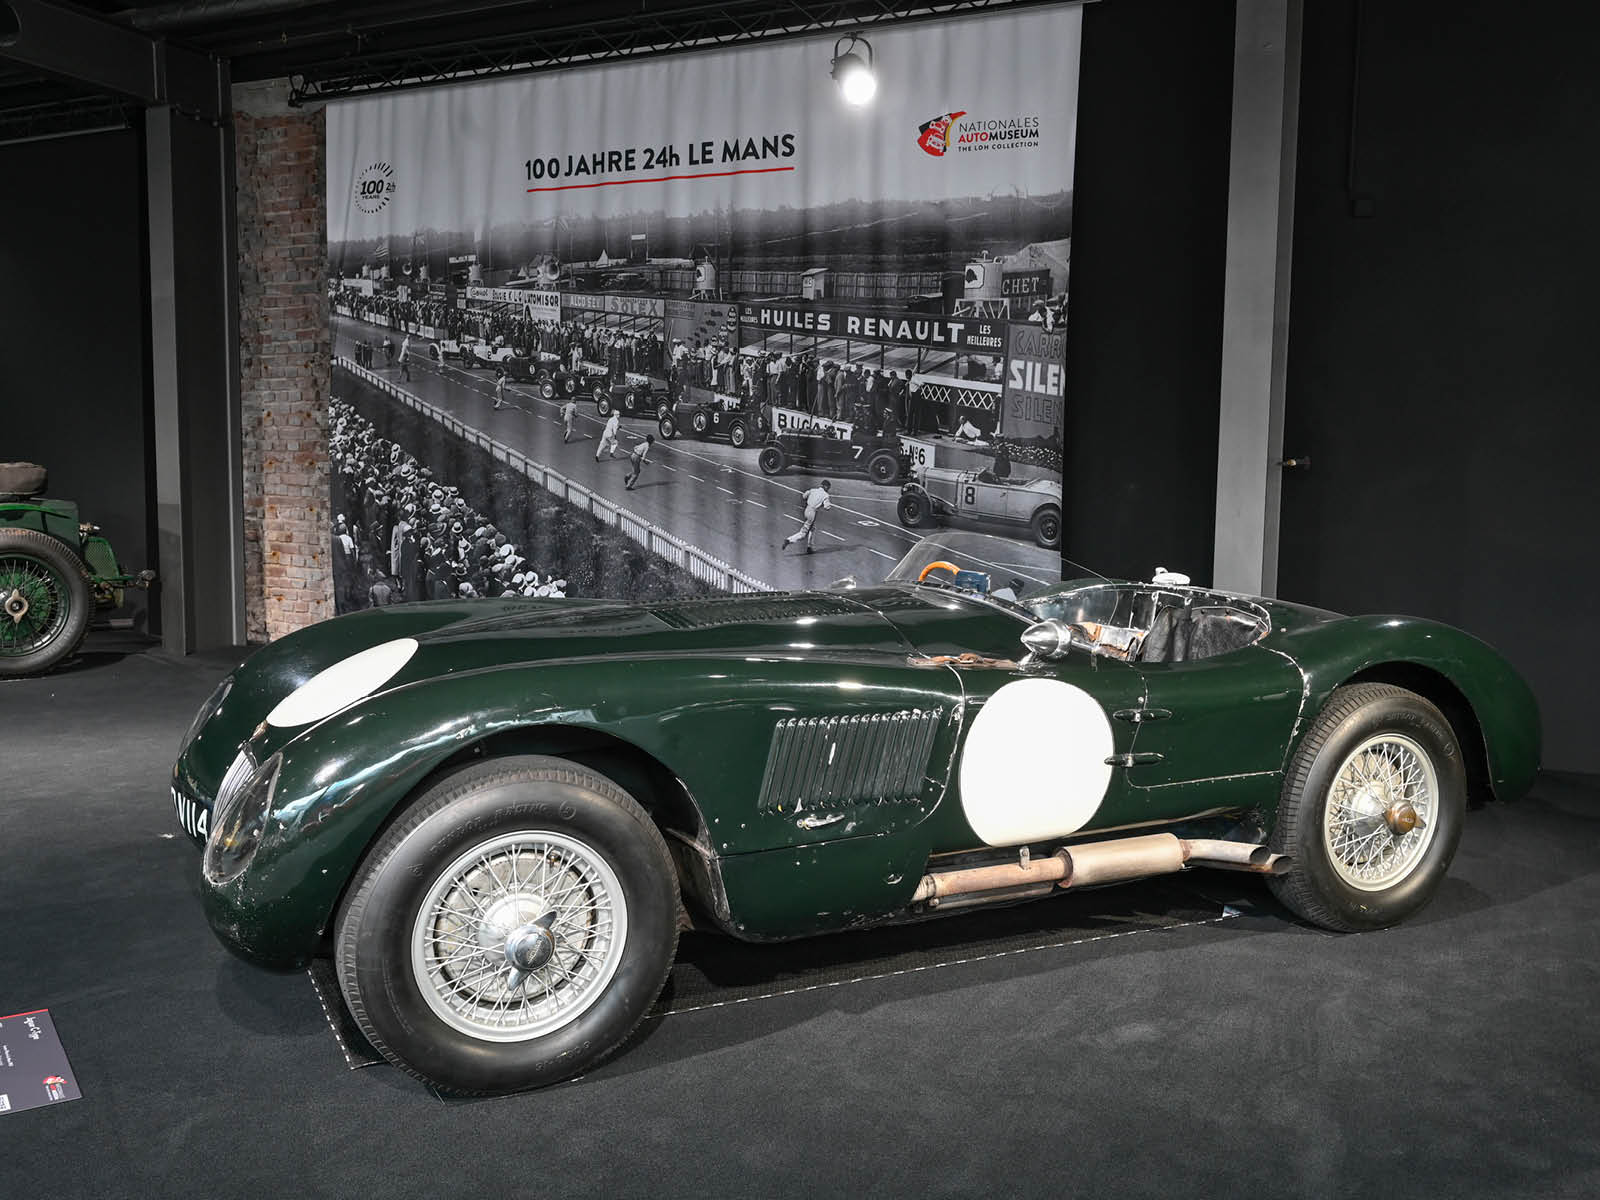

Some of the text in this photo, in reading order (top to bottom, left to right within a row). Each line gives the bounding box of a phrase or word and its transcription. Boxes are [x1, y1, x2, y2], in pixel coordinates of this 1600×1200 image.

[959, 116, 1039, 132] NATIONALES
[958, 128, 1039, 143] AUTOMUSEUM
[991, 141, 1039, 150] COLLECTION
[525, 133, 796, 180] 100 JAHRE 24h LE MANS
[360, 179, 384, 195] 100
[761, 308, 831, 331] HUILES
[847, 316, 965, 343] RENAULT
[979, 324, 991, 335] LES
[713, 413, 720, 424] 6
[851, 446, 864, 459] 7
[965, 487, 976, 505] 8
